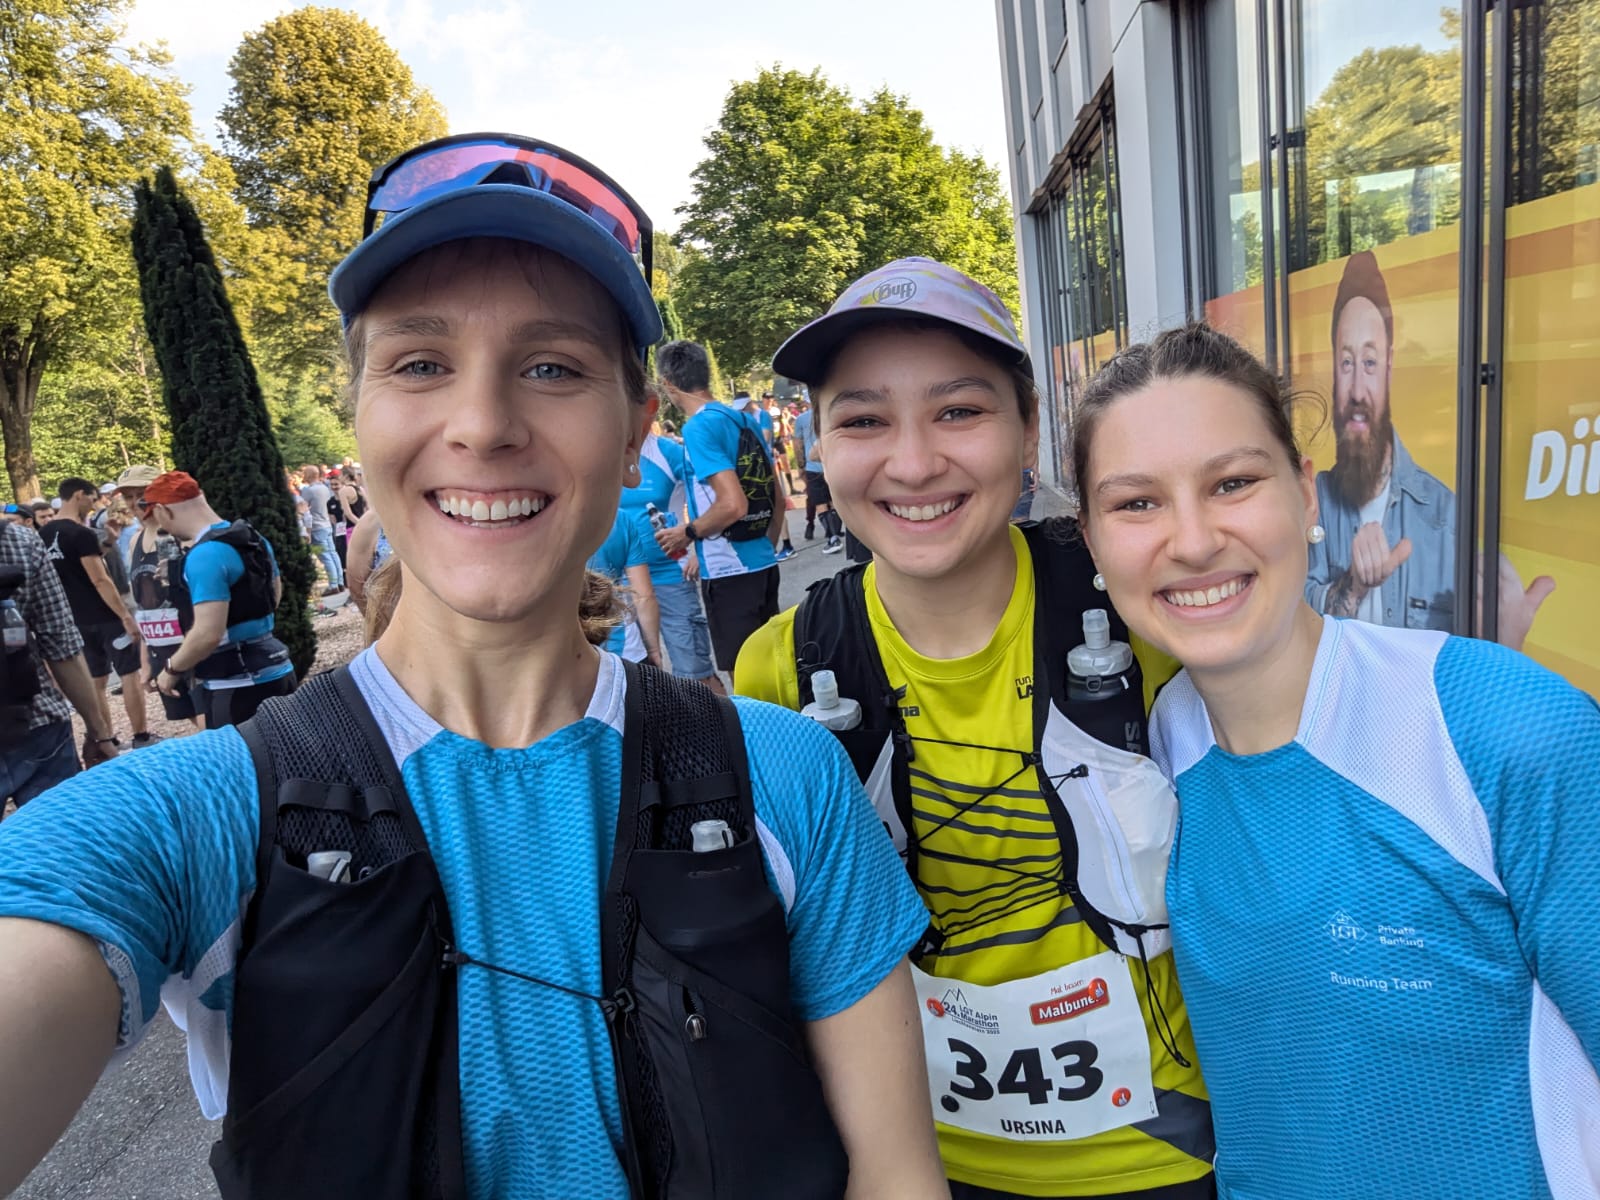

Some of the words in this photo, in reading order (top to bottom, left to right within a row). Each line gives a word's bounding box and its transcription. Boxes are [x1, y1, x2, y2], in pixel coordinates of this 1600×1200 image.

[1377, 924, 1416, 936] Private
[1379, 936, 1424, 948] Banking
[1330, 971, 1388, 992] Running
[1391, 978, 1432, 990] Team
[1038, 995, 1099, 1020] Malbune
[960, 1012, 999, 1028] Marathon
[975, 1011, 998, 1021] Alpin
[947, 1038, 1104, 1105] 343
[1000, 1119, 1066, 1134] URSINA
